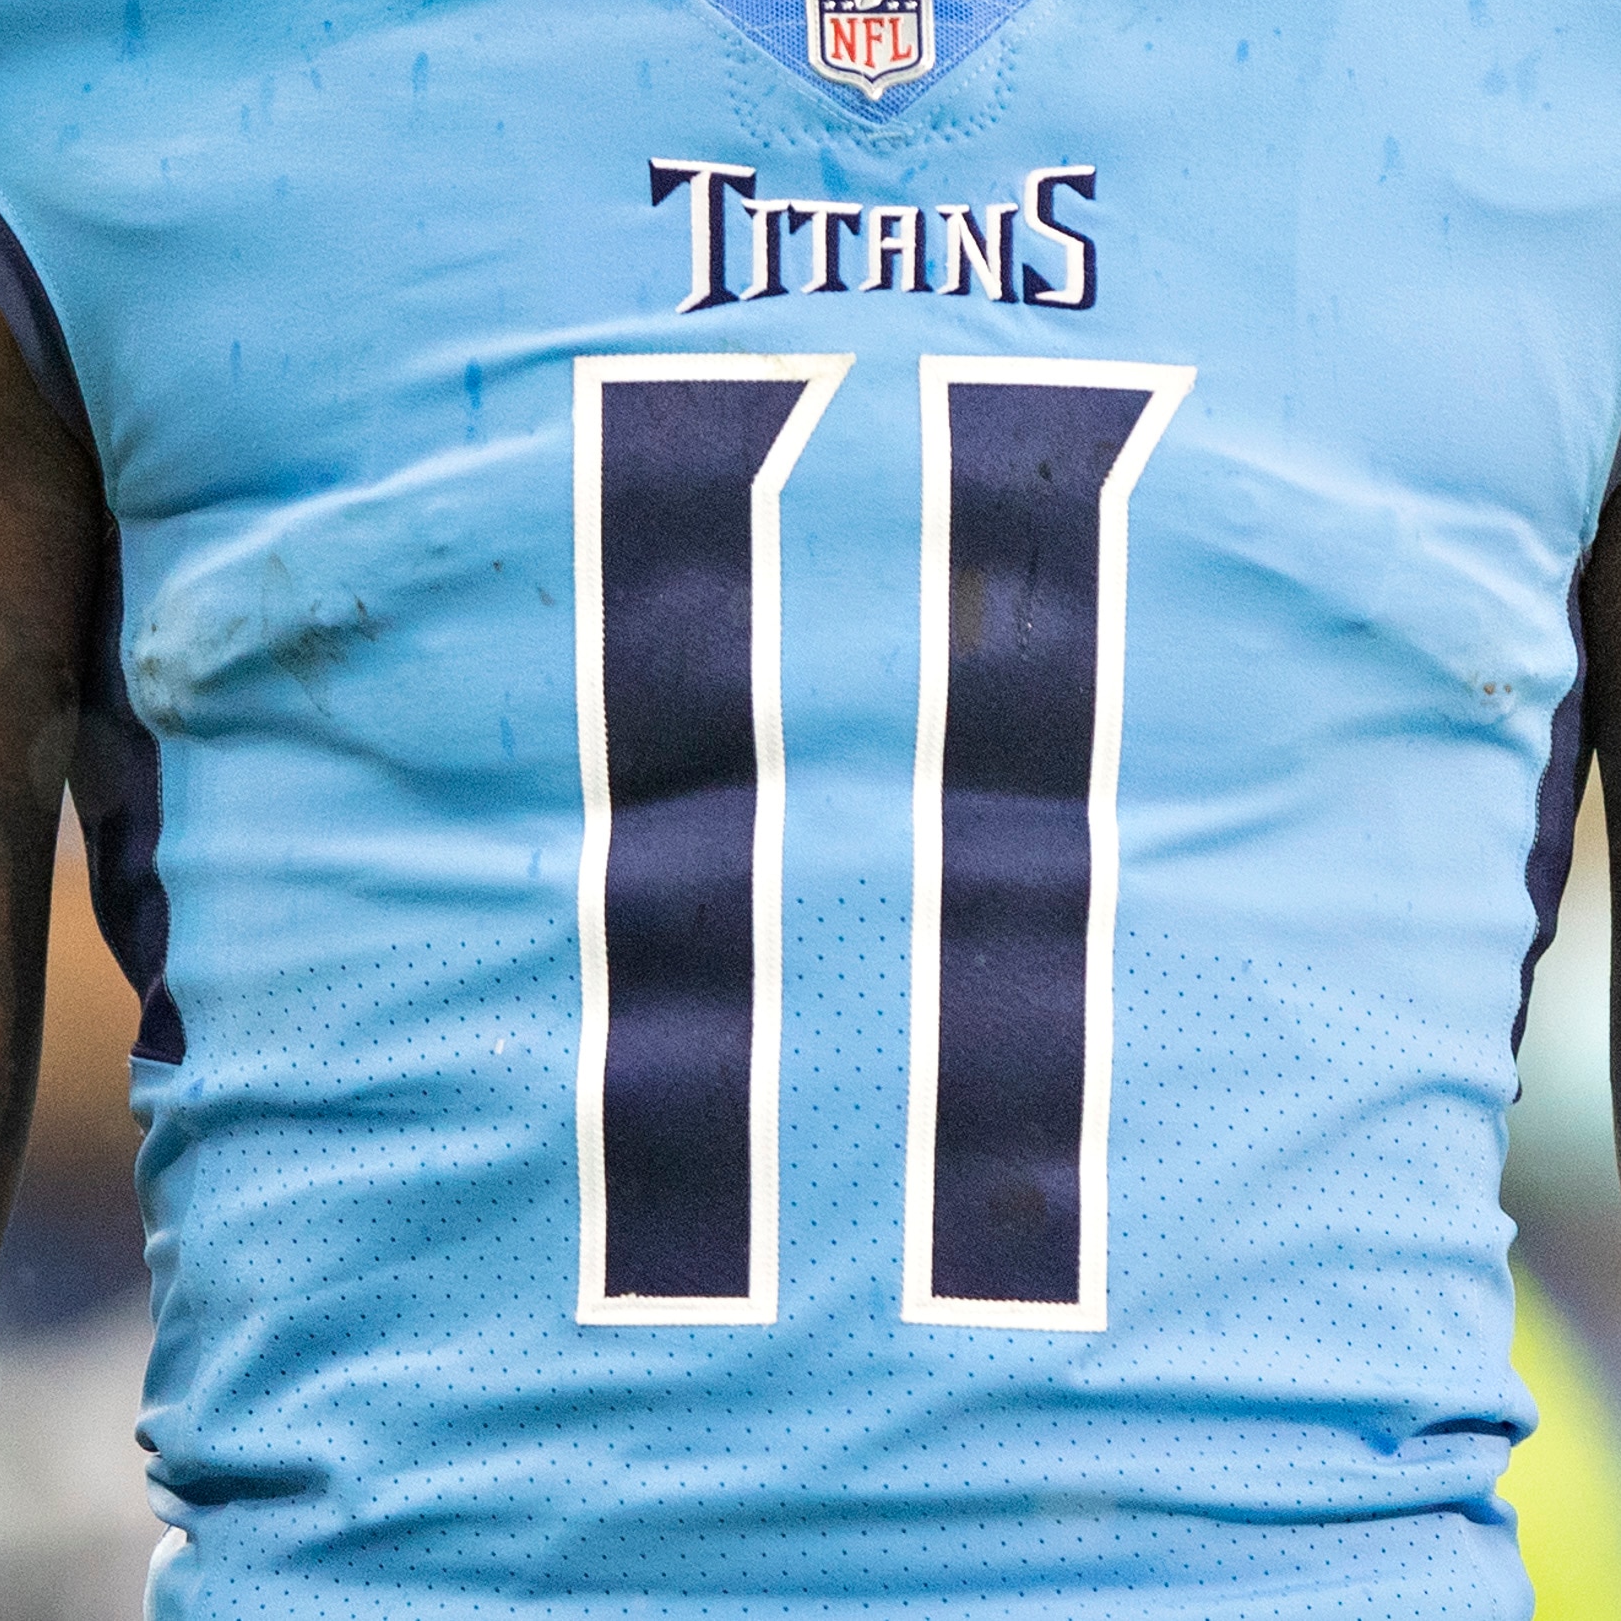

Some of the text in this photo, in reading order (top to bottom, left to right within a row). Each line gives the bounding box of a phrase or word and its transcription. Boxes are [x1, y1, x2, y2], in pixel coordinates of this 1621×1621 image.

[829, 16, 913, 69] NFL
[649, 157, 1097, 314] TITANS
[573, 353, 1197, 1332] 11
